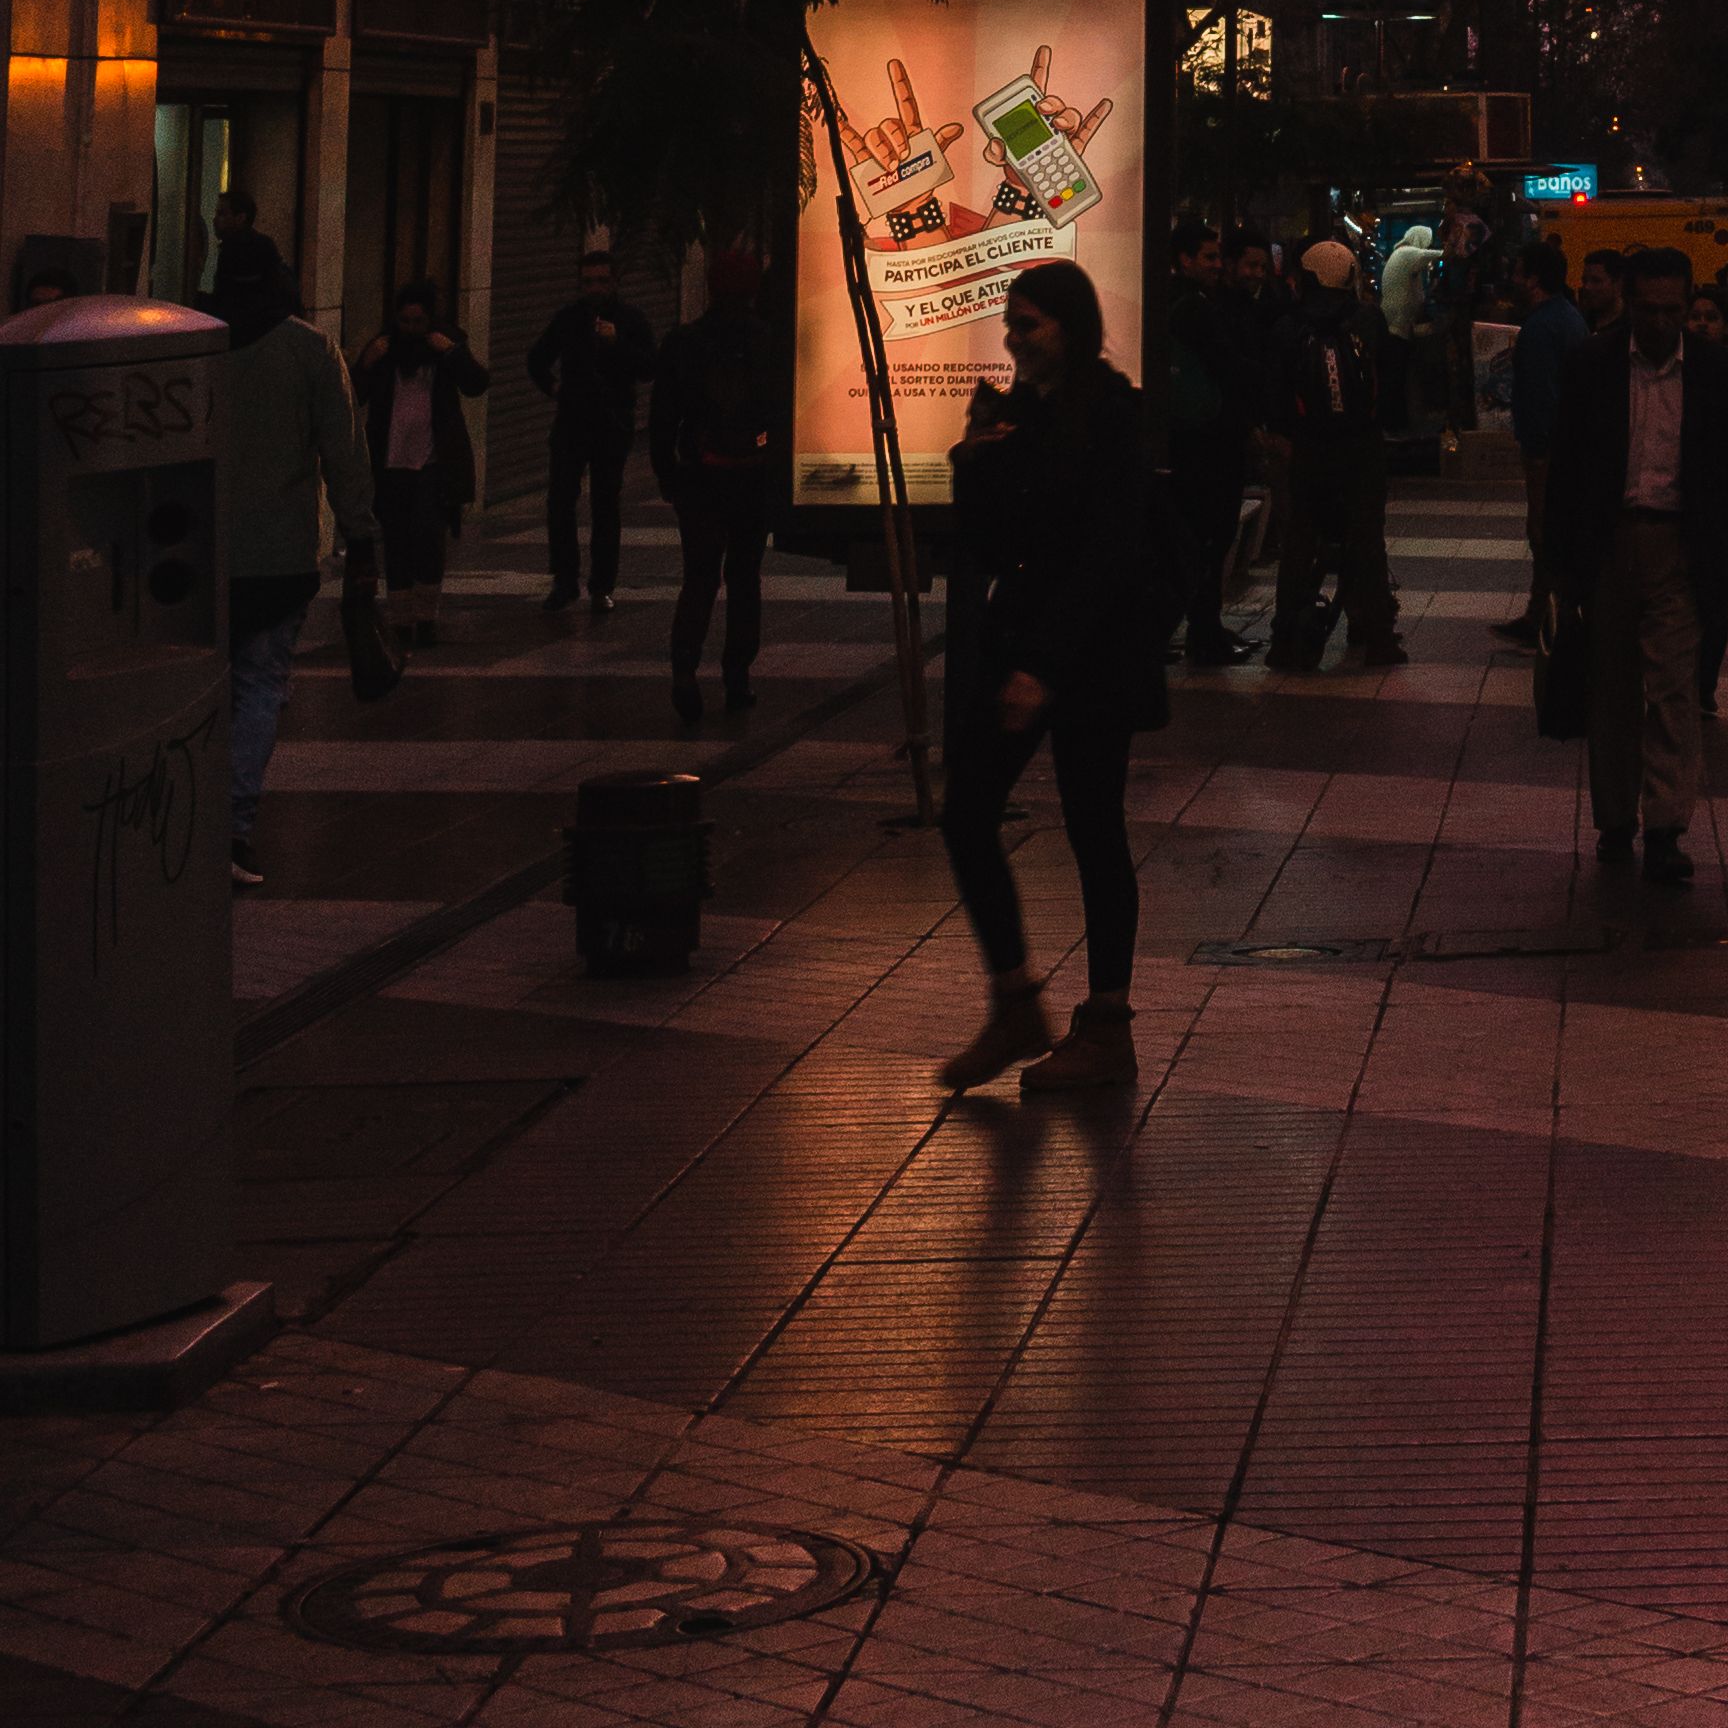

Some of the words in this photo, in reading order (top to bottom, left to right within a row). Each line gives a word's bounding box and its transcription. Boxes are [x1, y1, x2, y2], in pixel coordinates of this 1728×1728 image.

[878, 171, 899, 188] Red
[900, 156, 932, 178] compra
[884, 258, 965, 283] PARTICIPA
[965, 253, 986, 267] EL
[986, 236, 1054, 259] CLIENTE
[886, 260, 911, 268] HASTA
[911, 258, 926, 267] POR
[927, 244, 977, 263] REDCOMPRAR
[978, 234, 1008, 249] HUEVOS
[1008, 230, 1026, 240] CON
[1026, 227, 1053, 236] ACEITE
[905, 305, 916, 318] Y
[920, 302, 940, 315] EL
[941, 289, 975, 312] QUE
[978, 278, 1016, 300] ATIE
[919, 317, 935, 327] UN
[936, 305, 973, 325] MILLÓN
[973, 300, 987, 312] DE
[893, 363, 941, 372] USANDO
[943, 363, 1013, 372] REDCOMPRA
[899, 376, 944, 384] SORTEO
[985, 376, 1011, 385] QUE
[903, 388, 926, 397] USA
[929, 388, 936, 397] Y
[940, 388, 948, 397] A
